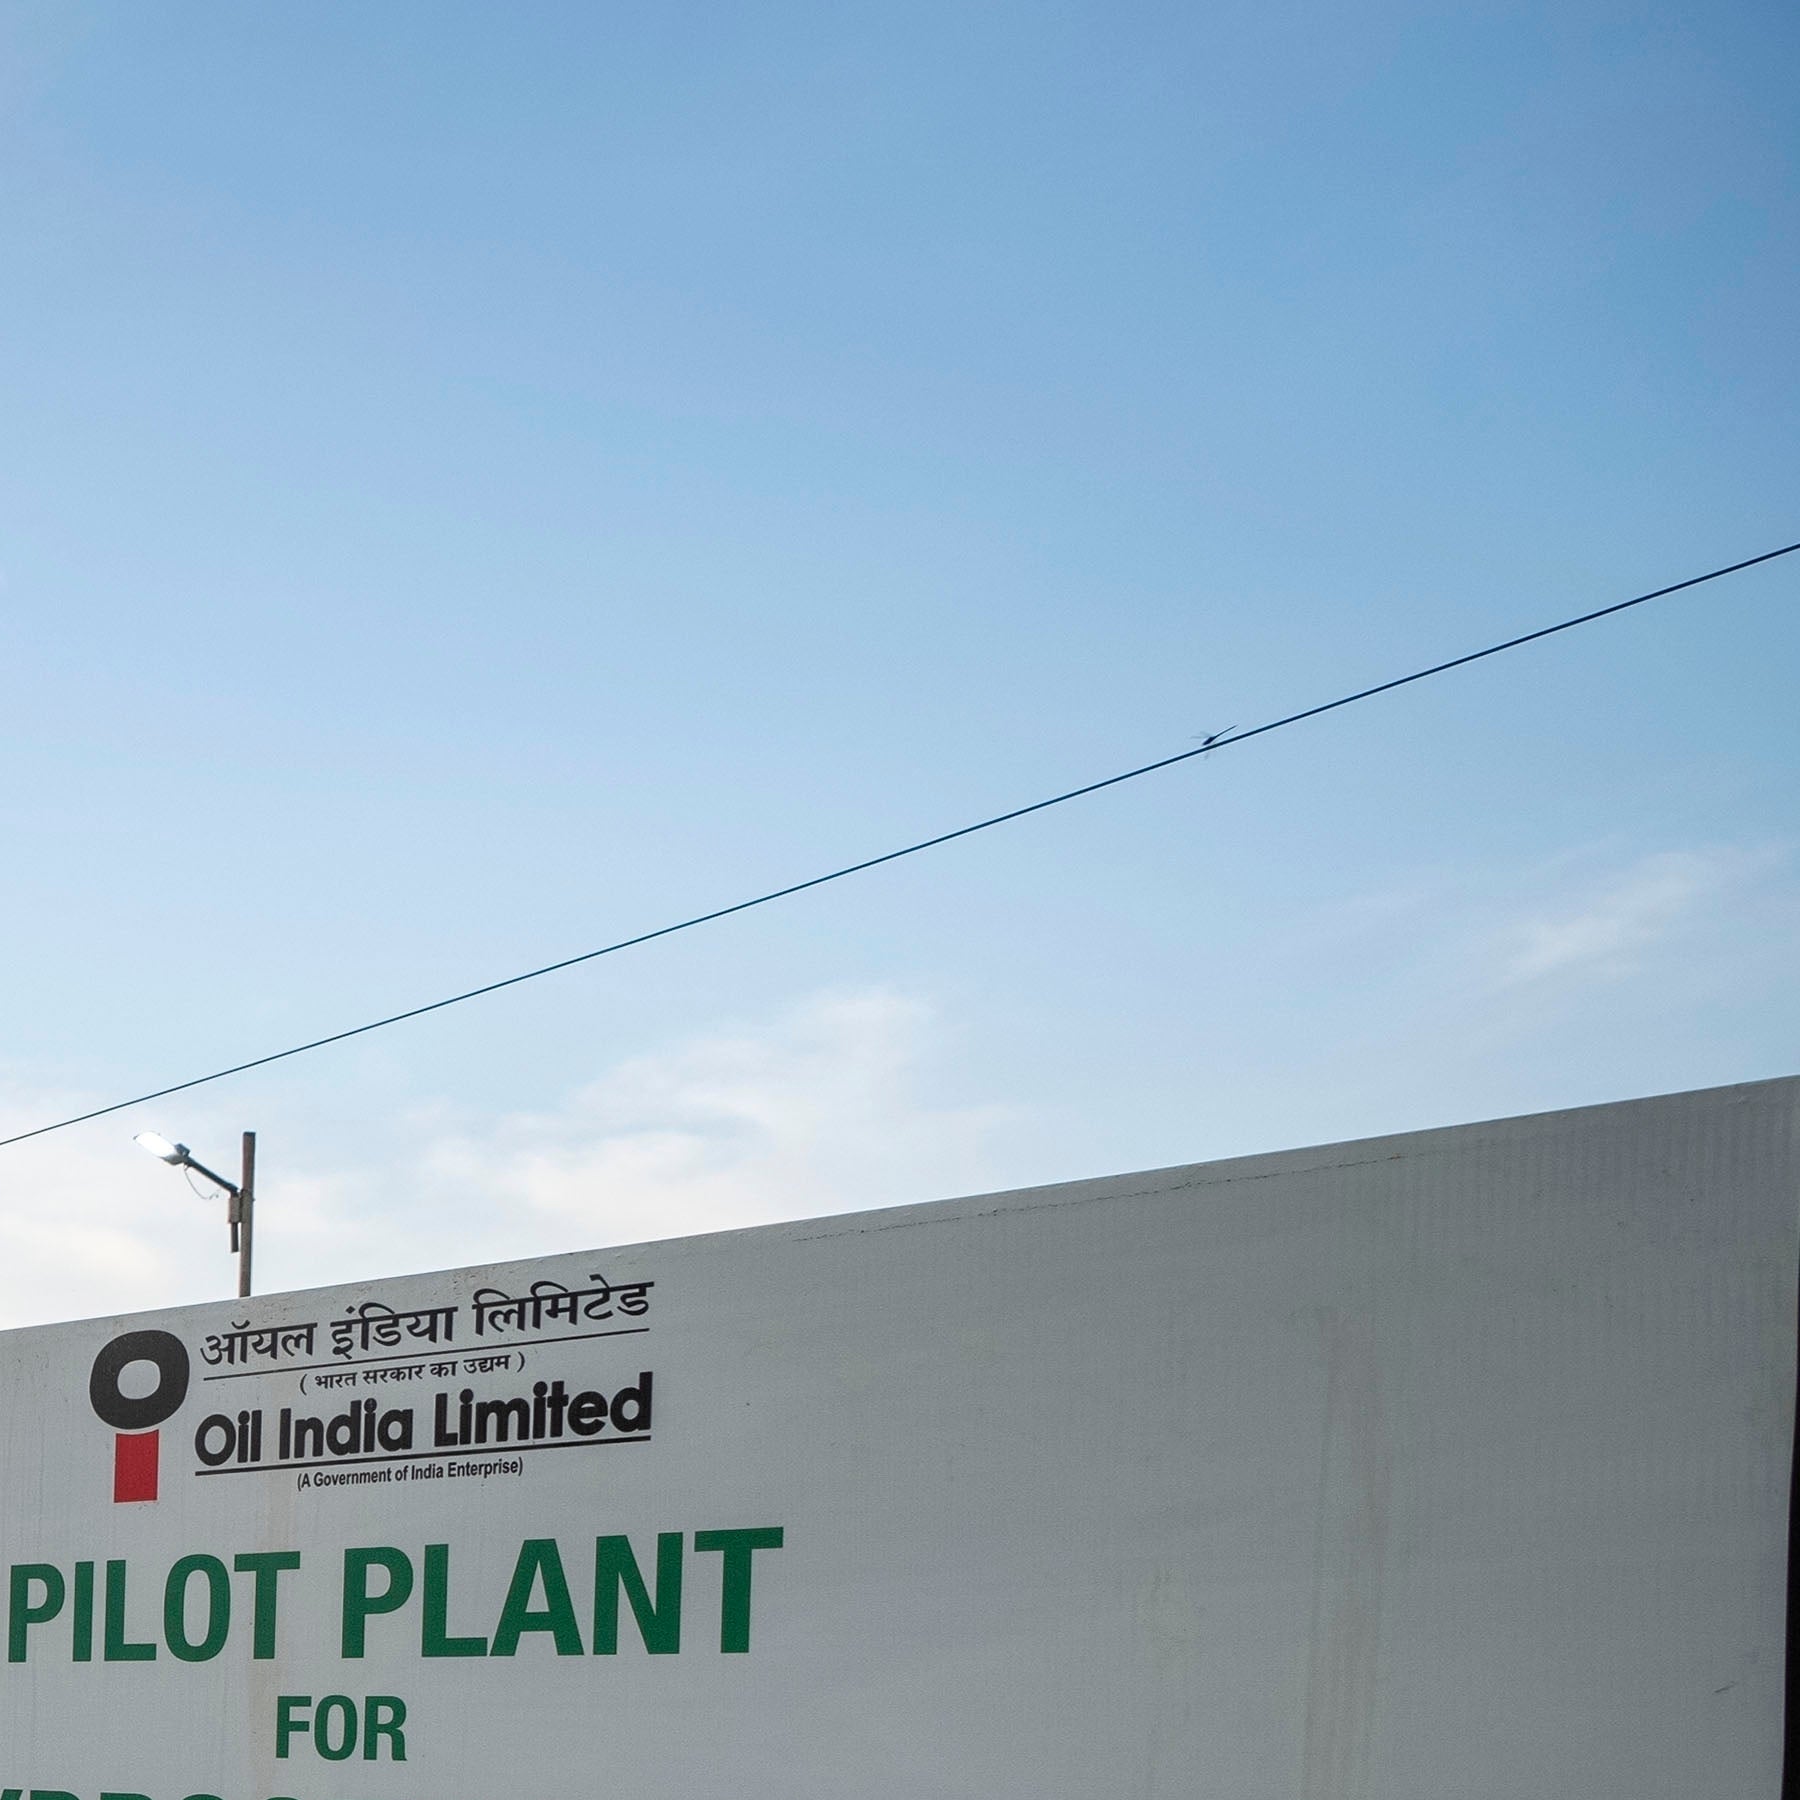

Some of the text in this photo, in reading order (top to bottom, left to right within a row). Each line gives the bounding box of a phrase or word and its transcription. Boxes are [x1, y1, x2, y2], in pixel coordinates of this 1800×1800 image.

[199, 1273, 655, 1366] ऑयल इंडिया लिमिटेड
[362, 1364, 426, 1385] सरकार
[429, 1360, 459, 1378] का
[194, 1371, 654, 1467] Oil India Limited
[296, 1456, 524, 1491] (A Government of India Enterprise)
[8, 1526, 786, 1665] PILOT PLANT
[276, 1694, 409, 1762] FOR
